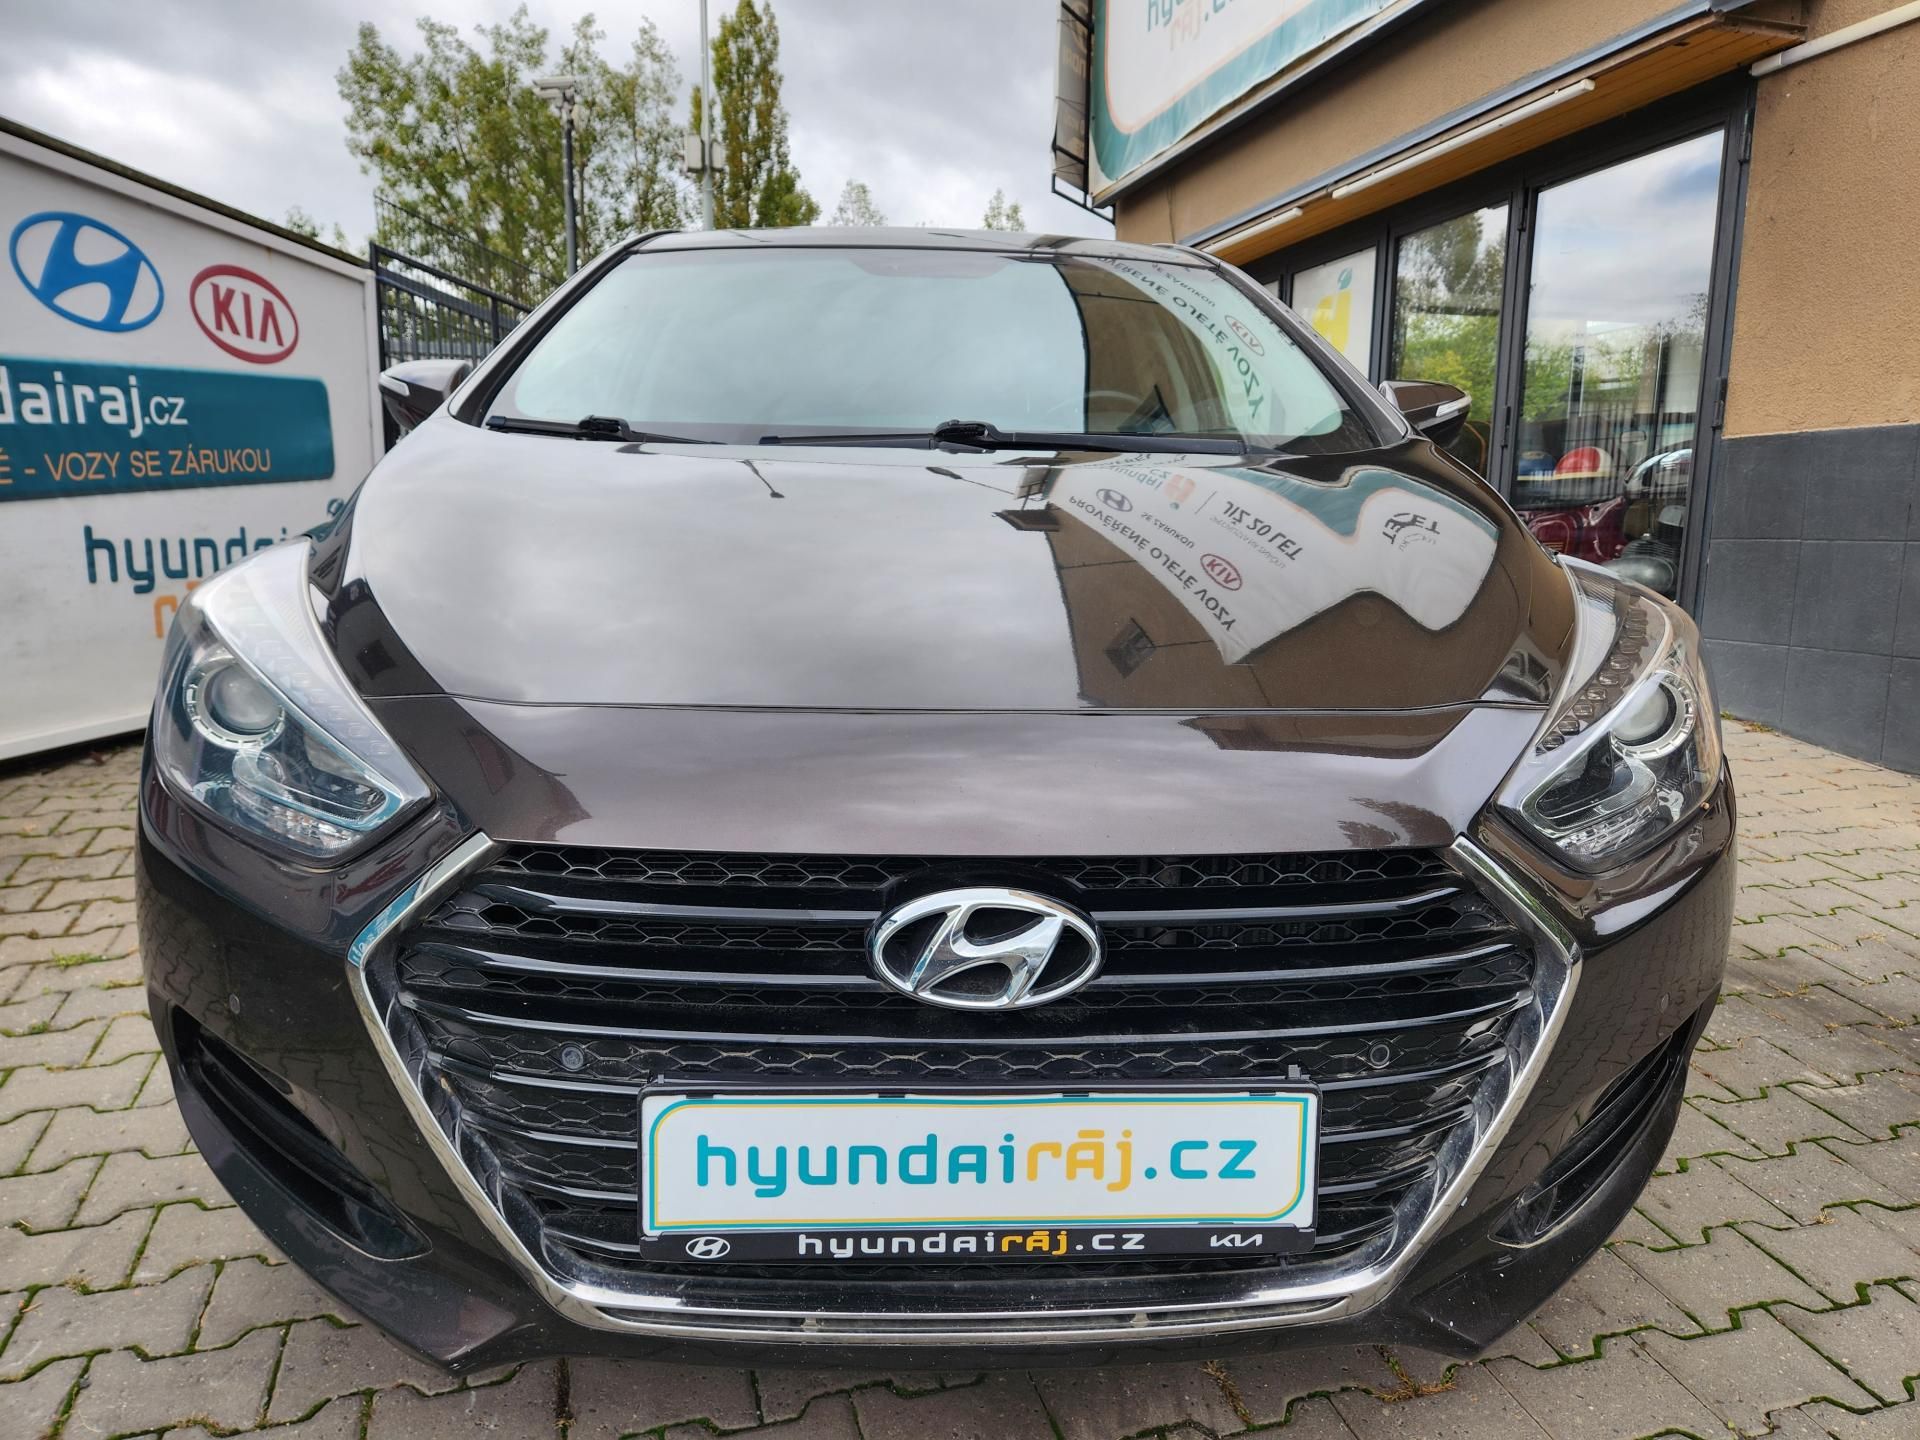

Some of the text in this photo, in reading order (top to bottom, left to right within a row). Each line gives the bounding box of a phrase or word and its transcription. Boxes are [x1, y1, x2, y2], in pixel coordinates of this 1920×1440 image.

[210, 282, 285, 347] KIA
[44, 451, 120, 481] VOZY
[130, 451, 163, 478] SE
[169, 444, 271, 475] ZÁRUKOU
